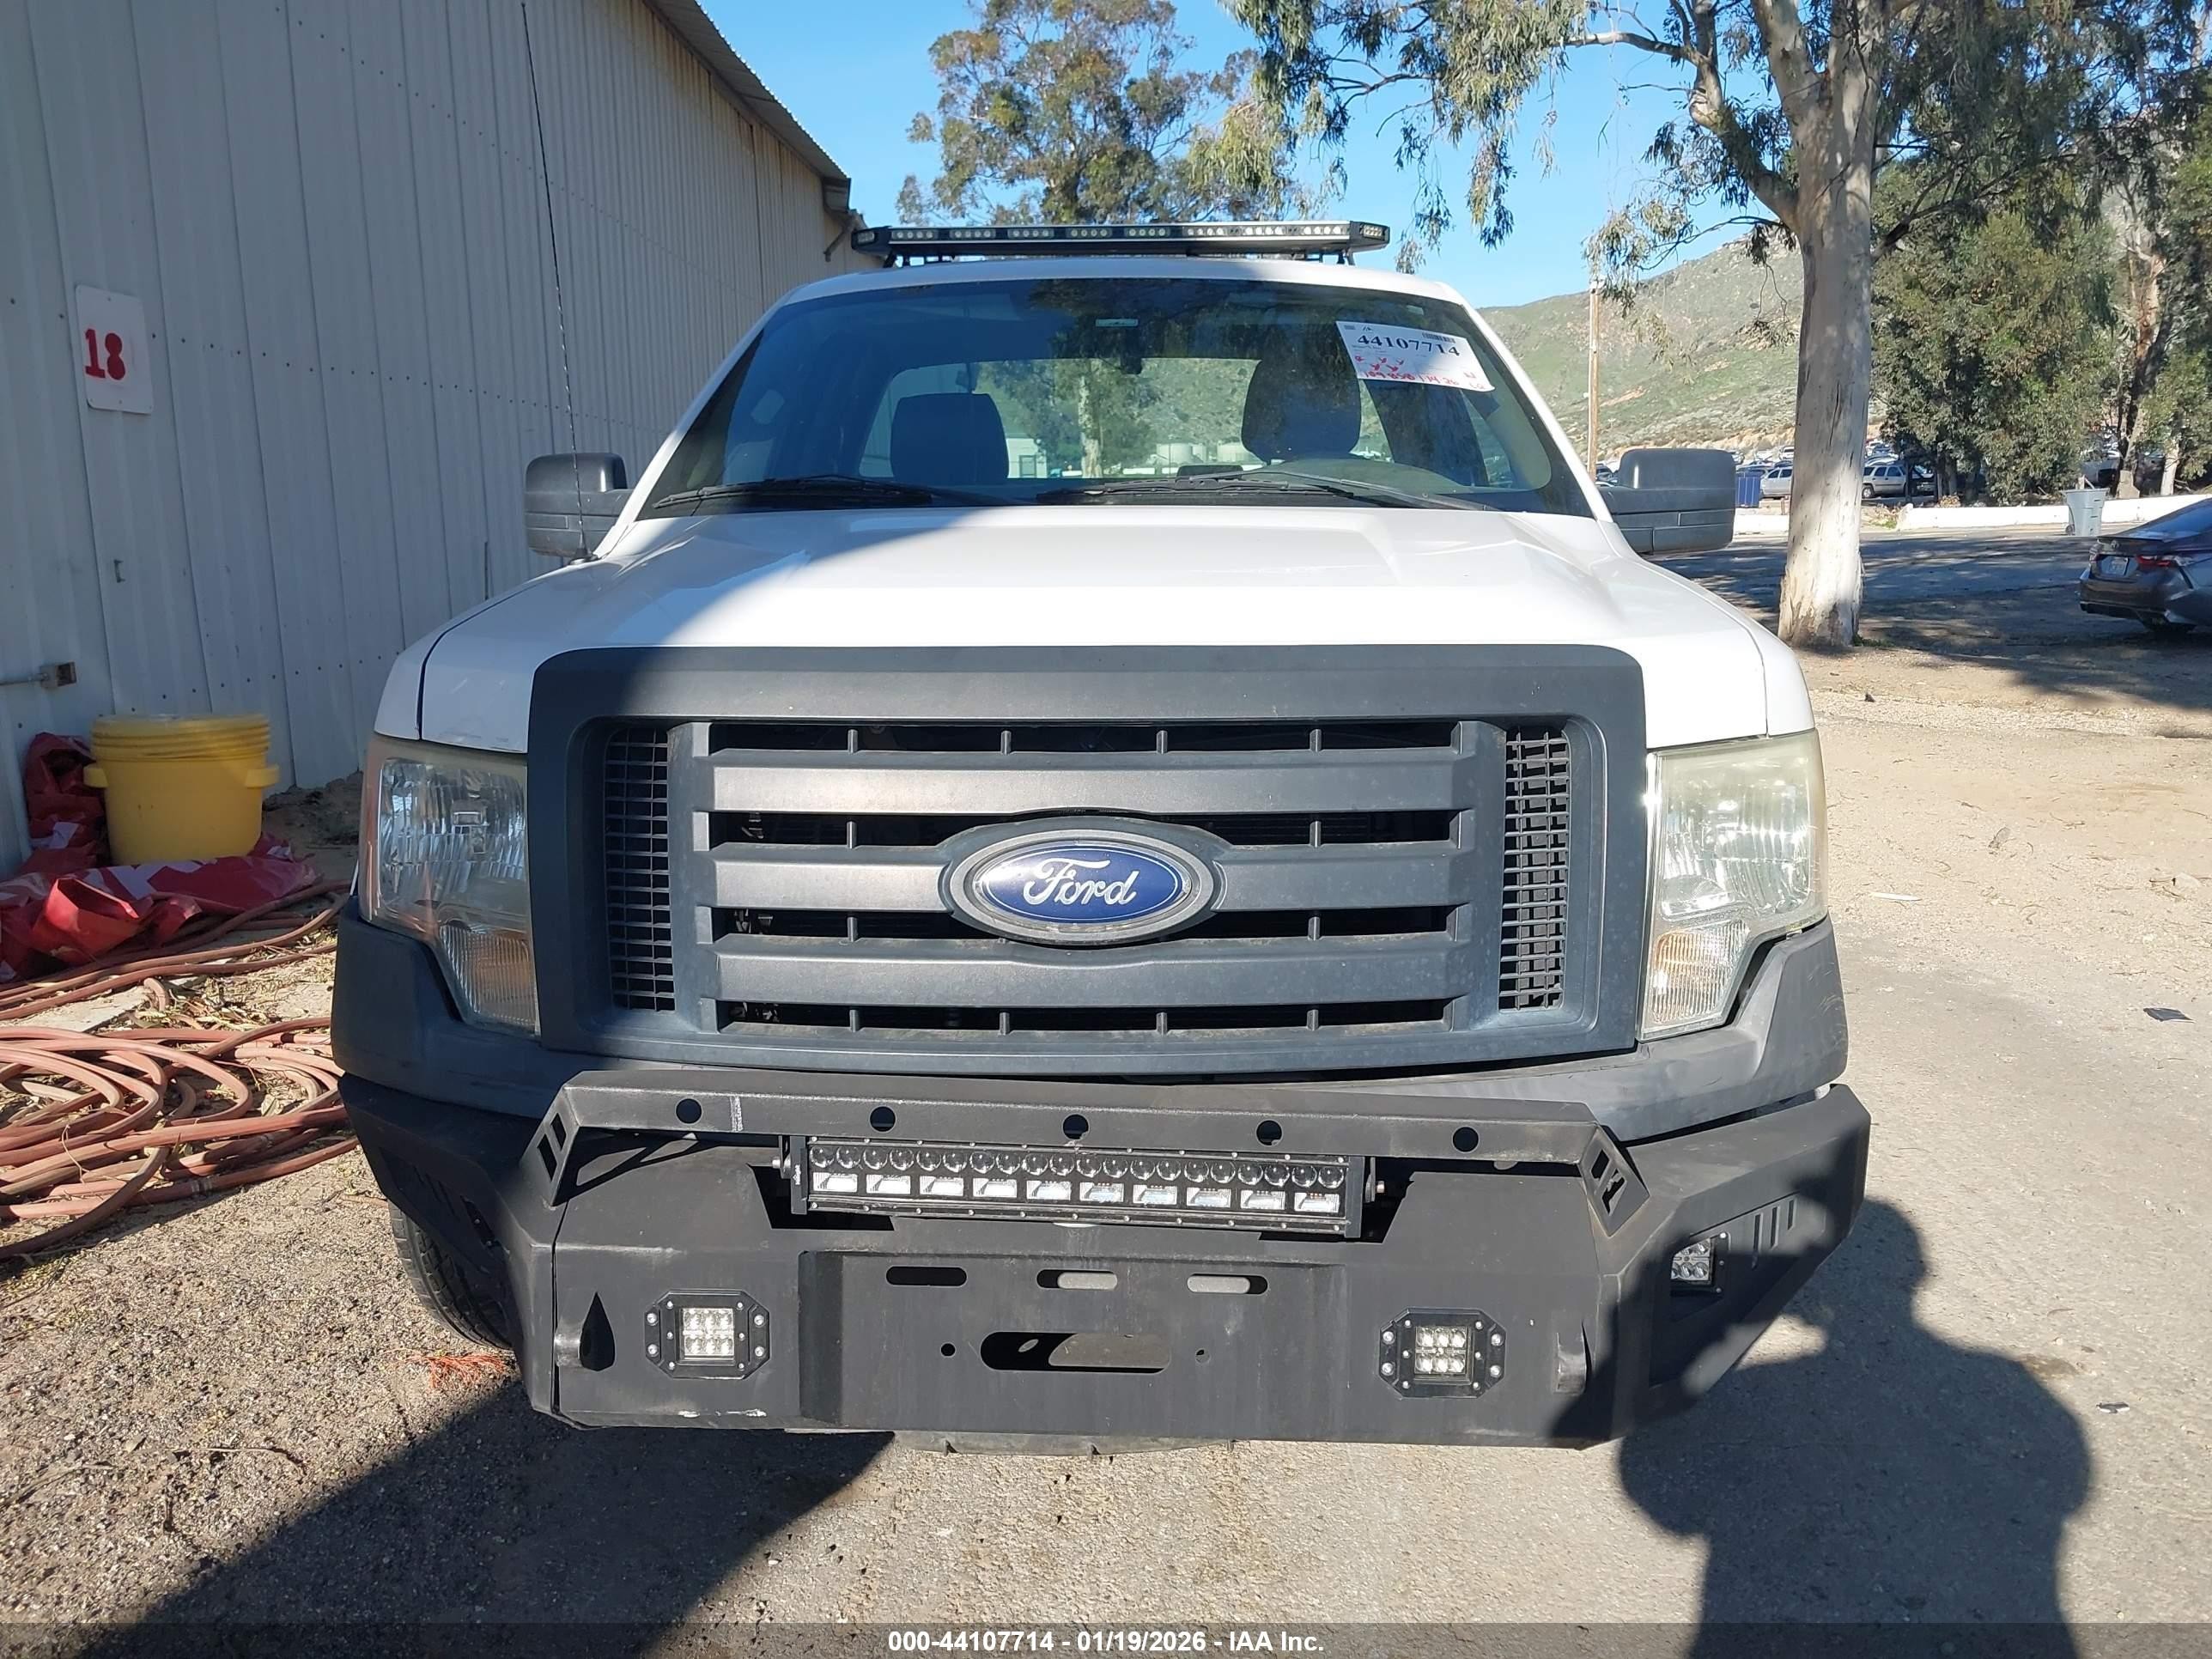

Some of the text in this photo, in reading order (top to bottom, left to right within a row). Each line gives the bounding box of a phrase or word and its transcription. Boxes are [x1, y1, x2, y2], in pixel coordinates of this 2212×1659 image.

[85, 329, 125, 380] 18
[1358, 334, 1461, 356] 44107714
[1023, 858, 1140, 905] Ford
